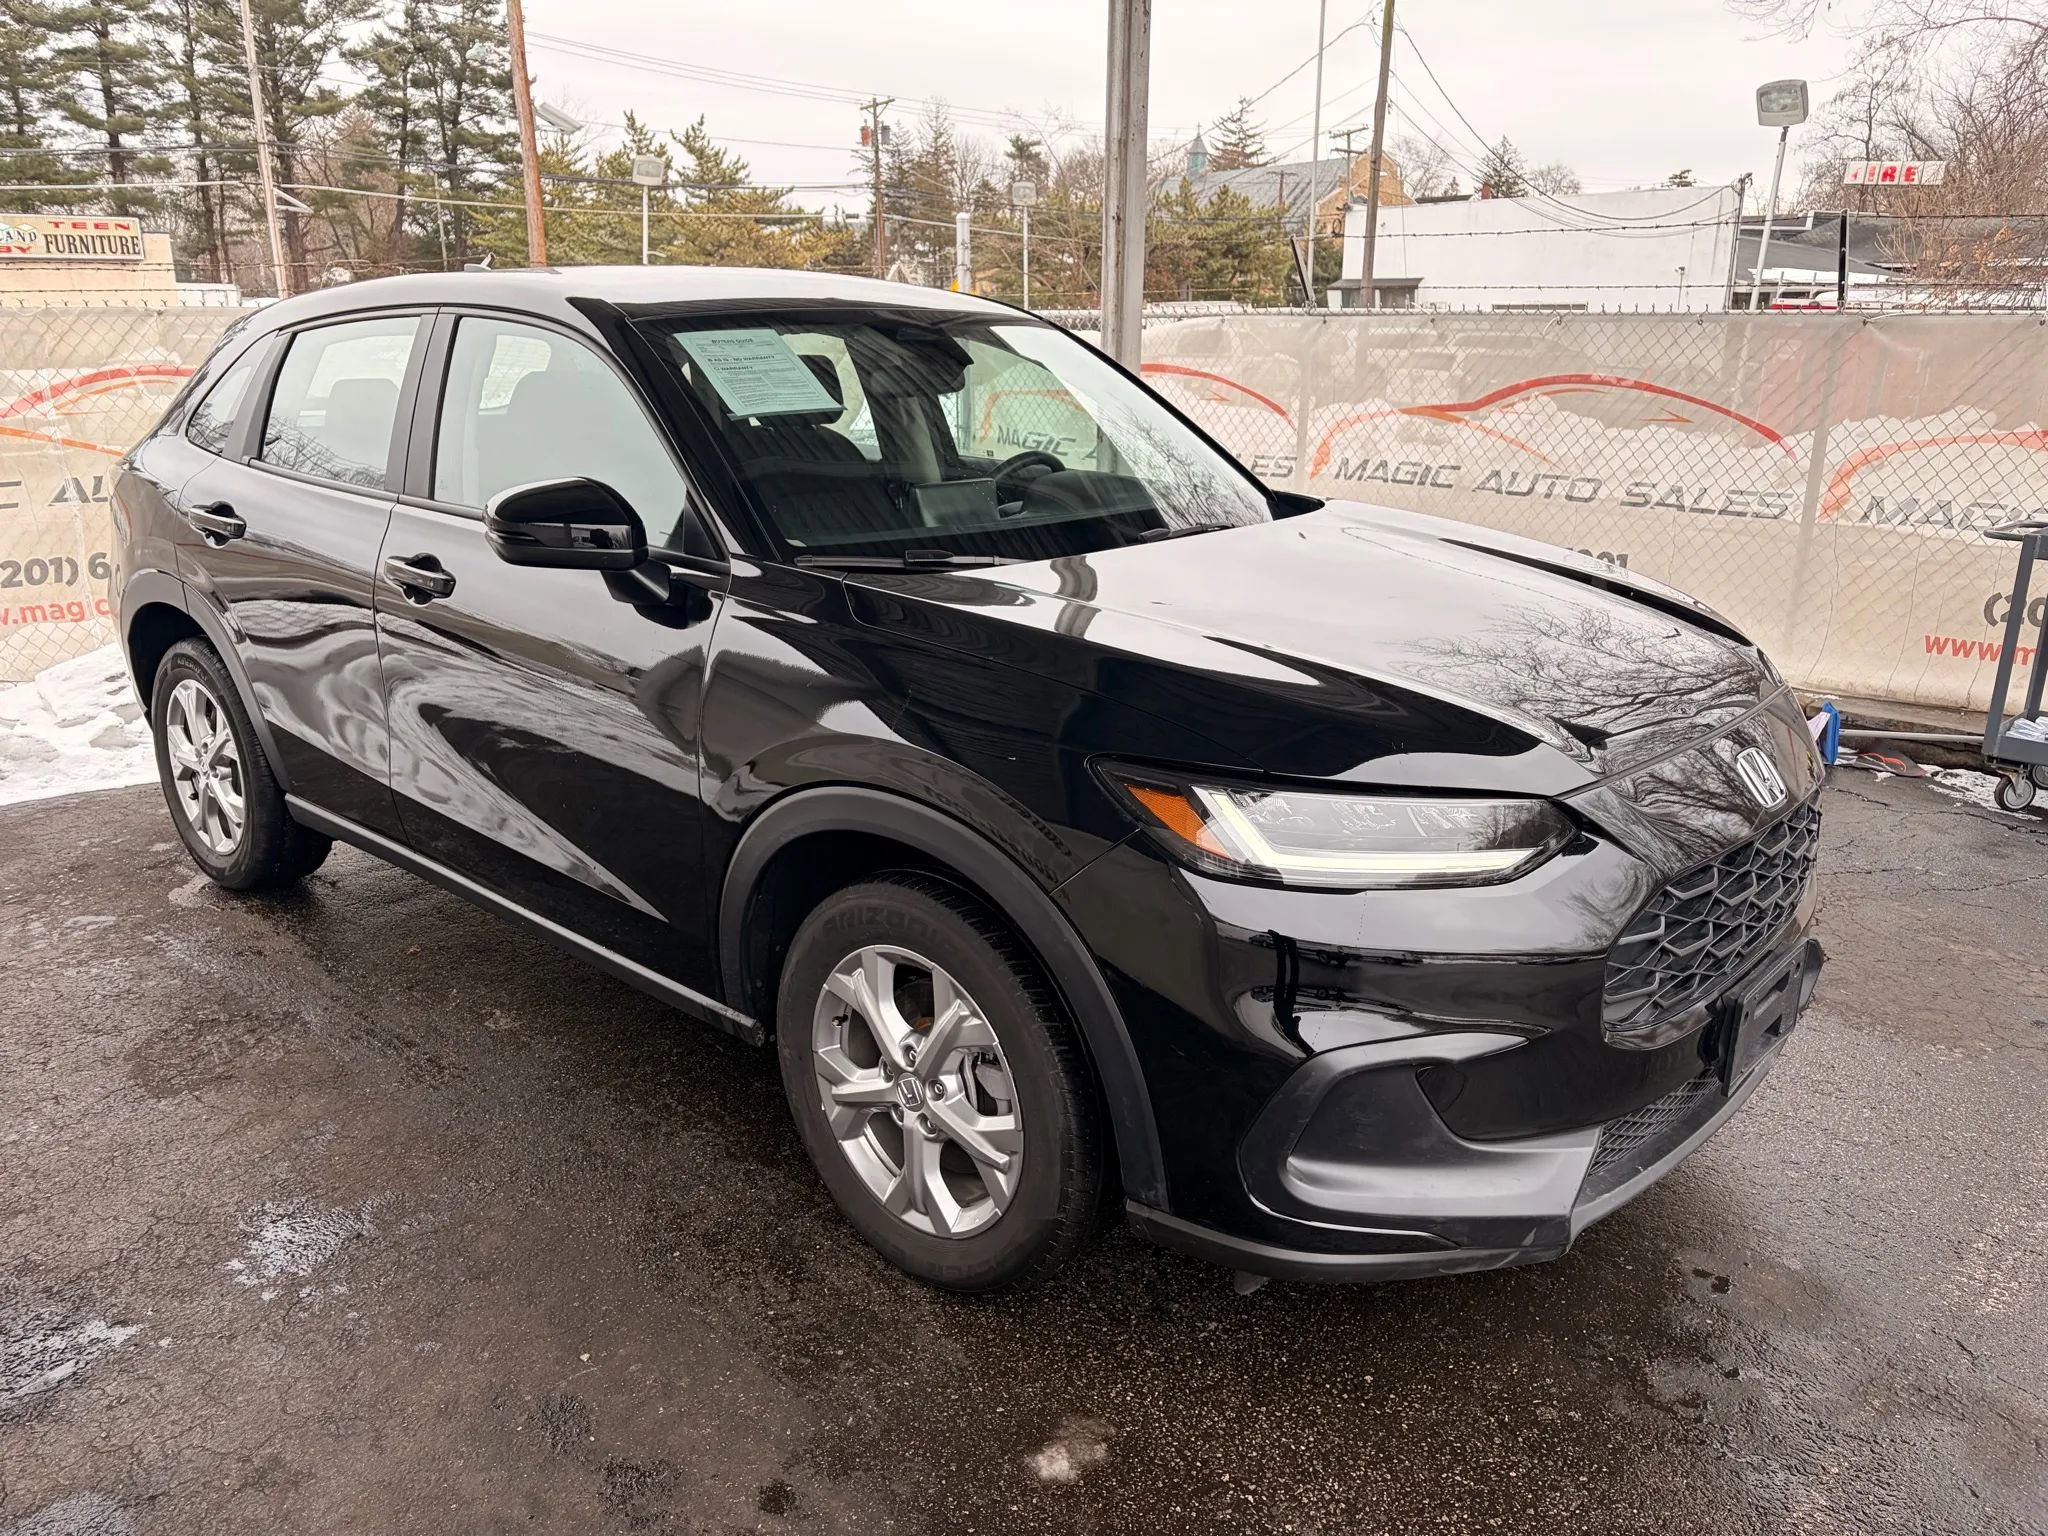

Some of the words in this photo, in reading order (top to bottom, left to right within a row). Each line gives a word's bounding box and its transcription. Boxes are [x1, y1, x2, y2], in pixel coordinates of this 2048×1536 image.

[0, 230, 37, 242] AND
[48, 221, 130, 230] TEEN
[43, 233, 140, 255] FURNITURE
[997, 425, 1077, 456] MAGIC
[1236, 453, 1298, 478] ES
[1334, 457, 1462, 489] MAGIC
[1472, 470, 1603, 503] AUTO
[1620, 482, 1796, 519] SALES
[0, 598, 111, 626] .magc
